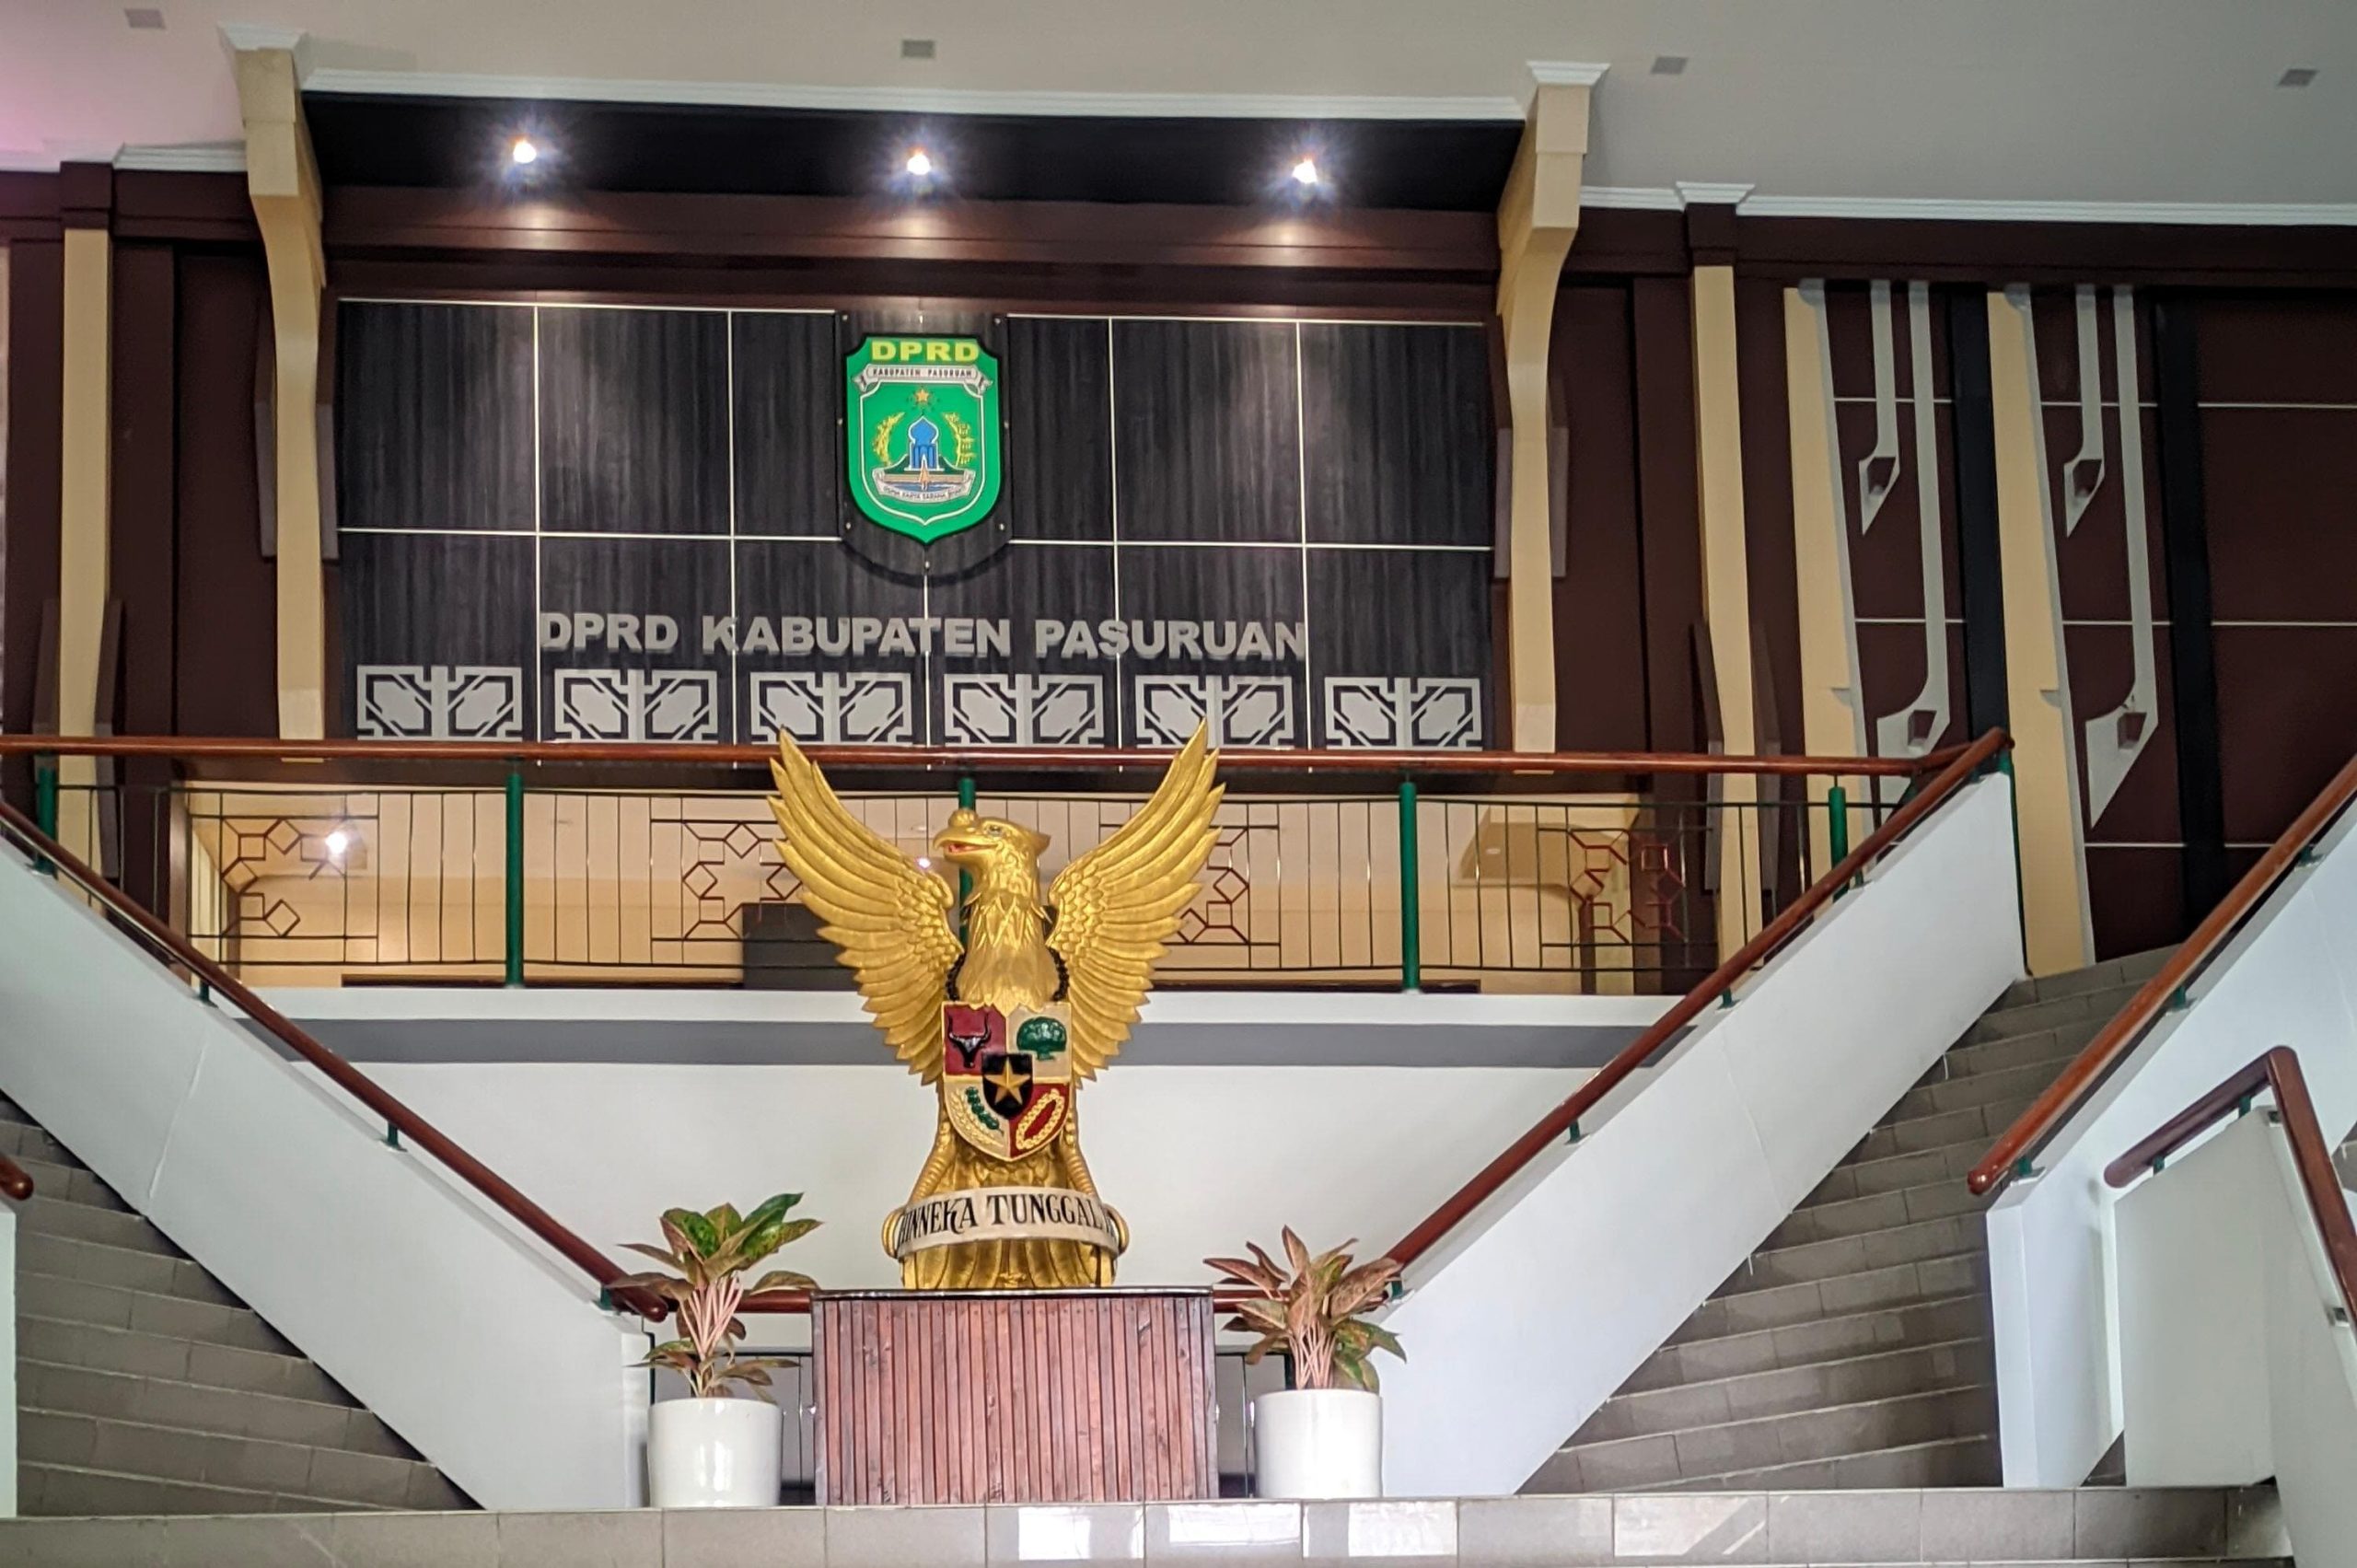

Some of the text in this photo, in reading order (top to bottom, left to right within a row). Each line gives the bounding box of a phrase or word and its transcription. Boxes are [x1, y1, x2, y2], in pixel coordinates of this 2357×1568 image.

[871, 341, 980, 361] DPRD
[540, 612, 1306, 661] DPRD KABUPATEN PASURUAN
[897, 1197, 979, 1245] HINNEKA
[985, 1192, 1103, 1231] TUNGGAL
